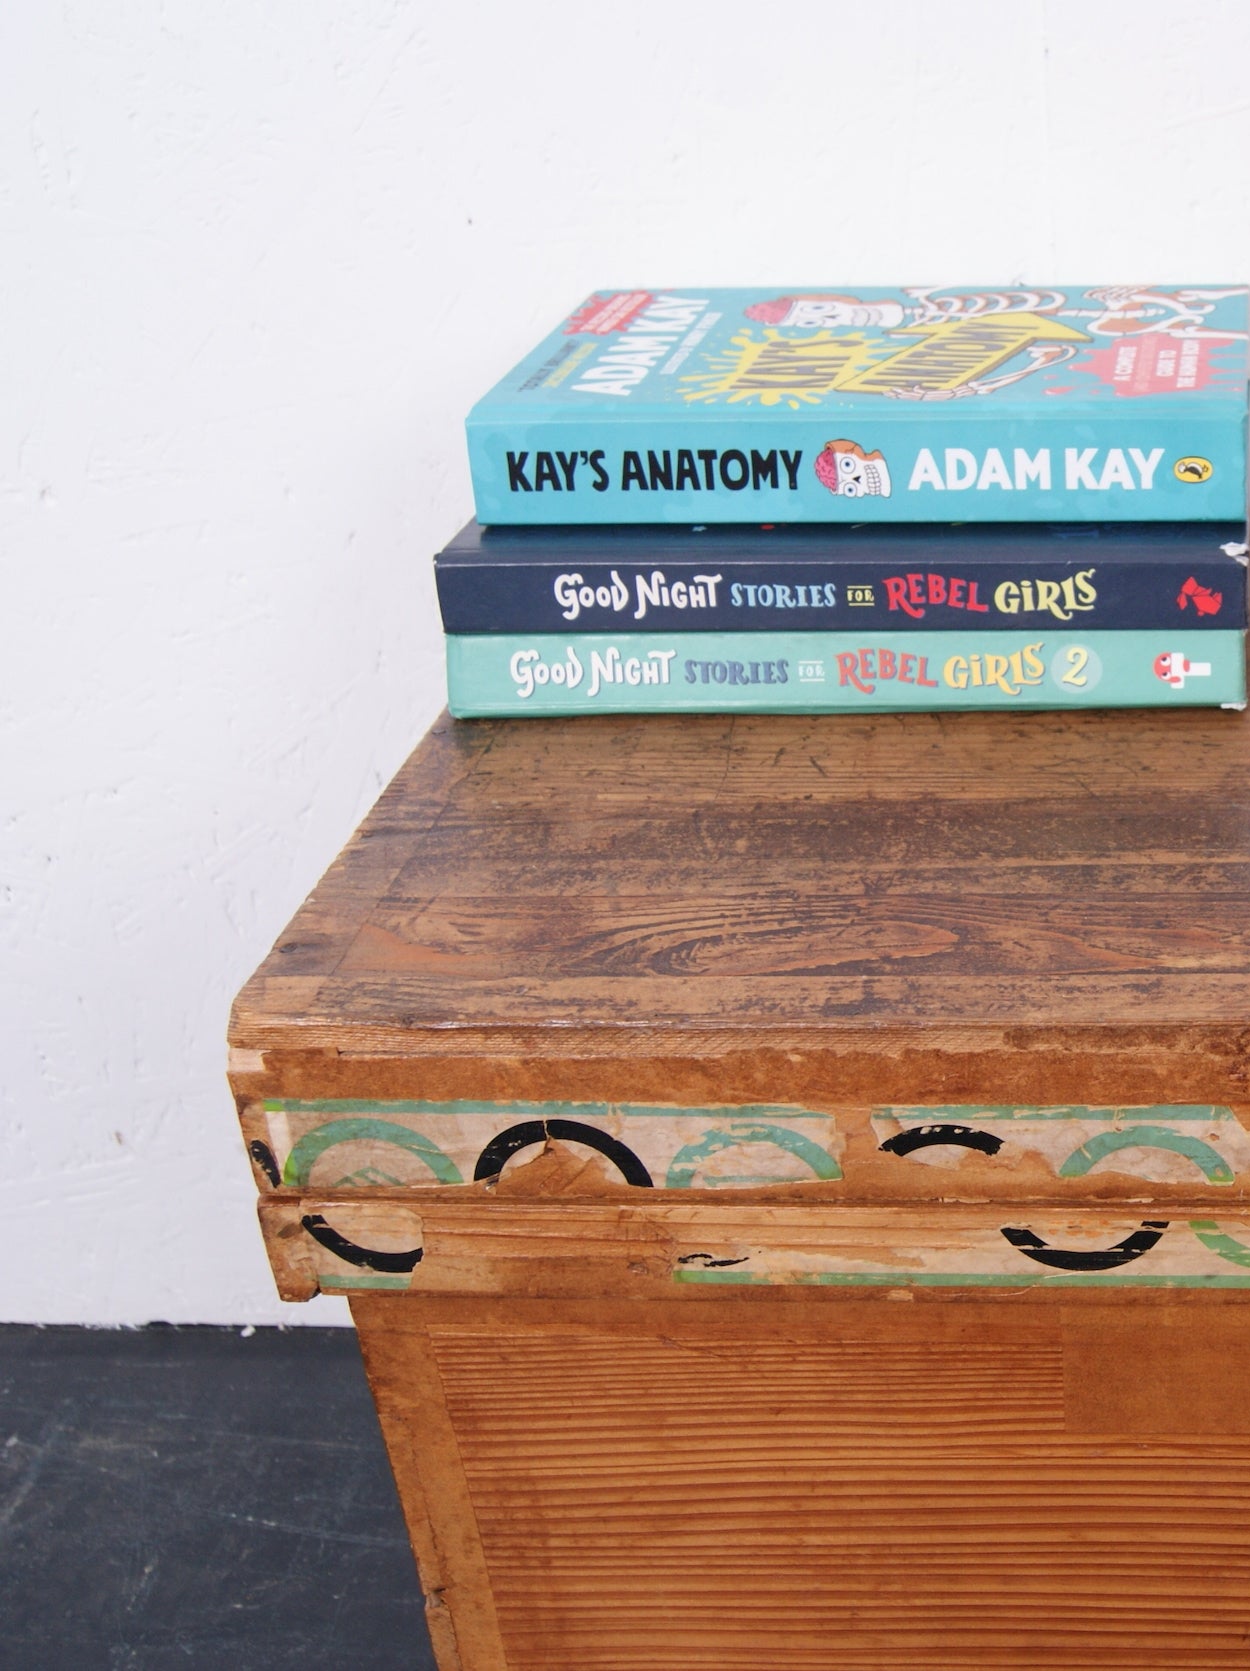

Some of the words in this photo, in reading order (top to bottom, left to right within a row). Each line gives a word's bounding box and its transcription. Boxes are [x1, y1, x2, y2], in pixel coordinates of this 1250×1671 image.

[571, 336, 679, 396] ADAM
[627, 296, 710, 332] KAY
[729, 339, 865, 389] KAY'S
[859, 321, 1039, 389] ANATOMY
[506, 450, 610, 492] KAY'S
[621, 449, 804, 491] ANATOMY
[908, 448, 1051, 491] ADAM
[1064, 448, 1165, 491] KAY
[730, 583, 836, 608] STORIES
[847, 587, 875, 604] FOR
[883, 573, 989, 619] REBEL
[994, 568, 1097, 621] GIRLS
[684, 659, 789, 685] STORIES
[798, 664, 825, 679] FOR
[834, 648, 939, 694] REBEL
[943, 641, 1045, 696] GIRLS
[1062, 646, 1089, 687] 2
